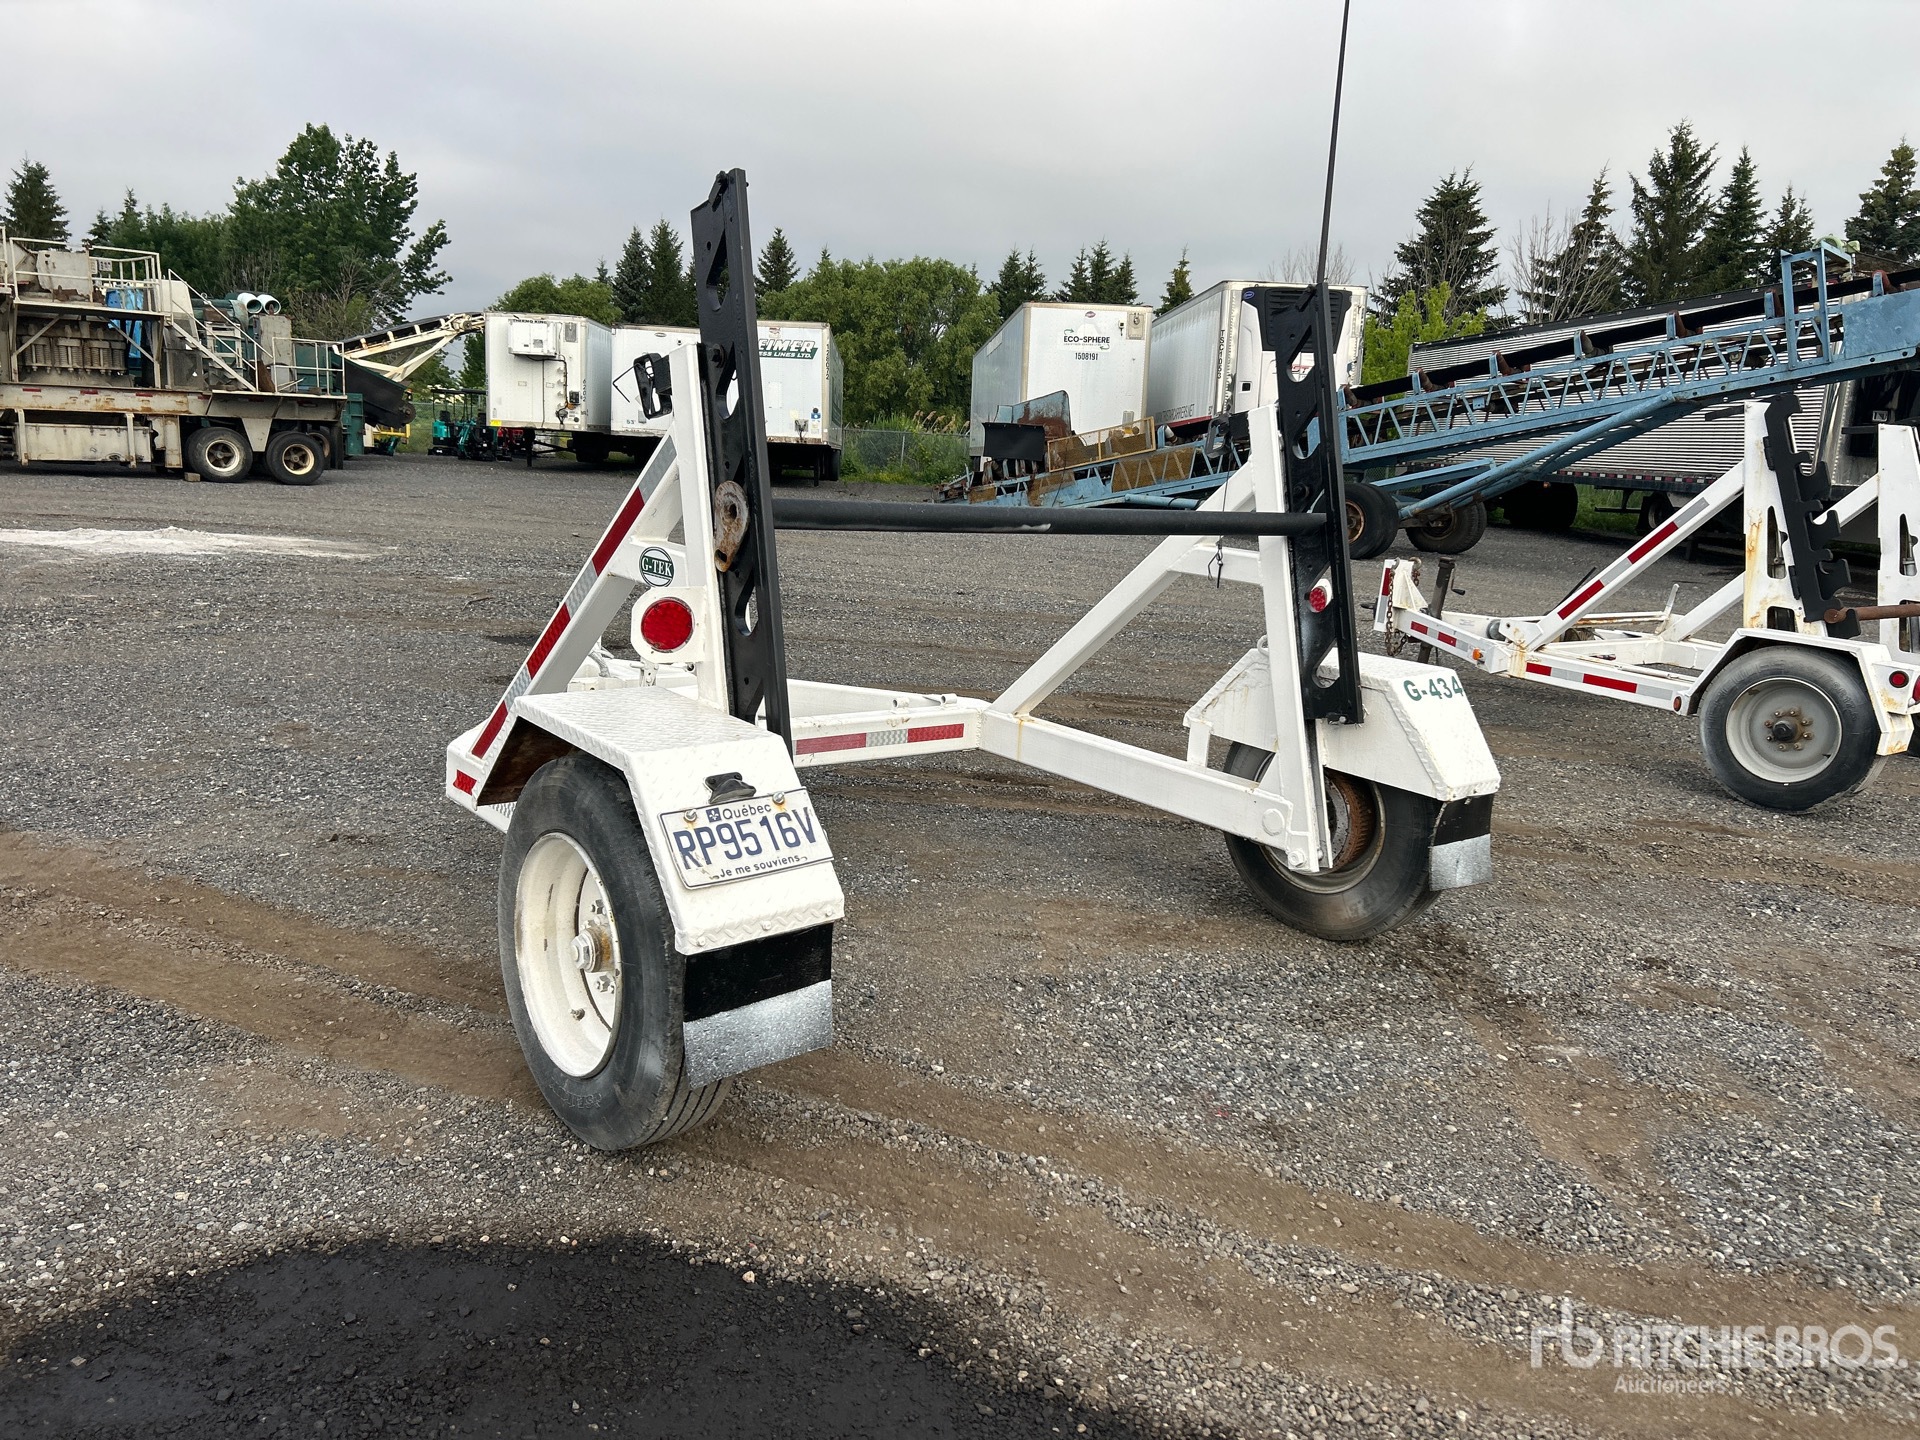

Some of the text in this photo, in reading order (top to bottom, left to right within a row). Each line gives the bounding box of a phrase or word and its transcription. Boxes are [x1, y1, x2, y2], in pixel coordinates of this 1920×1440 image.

[758, 339, 815, 353] EIMER
[1063, 335, 1110, 344] ECO-SPHERE
[1075, 352, 1099, 361] 1508191
[641, 557, 673, 577] G-TEK
[1403, 676, 1464, 702] G-434
[722, 803, 772, 820] Québec
[673, 806, 817, 870] RP9516V
[720, 853, 801, 878] Je me souviens
